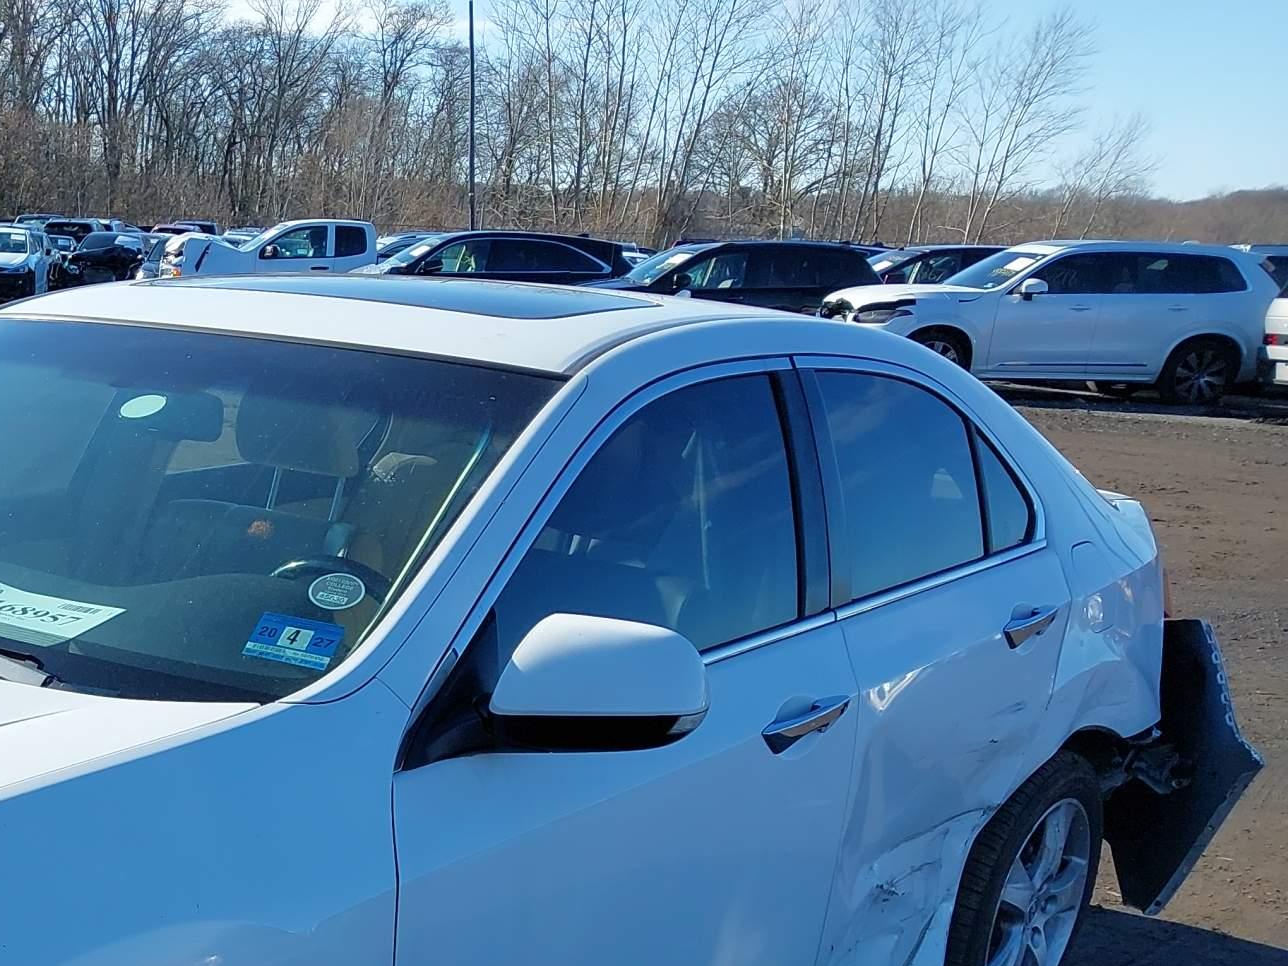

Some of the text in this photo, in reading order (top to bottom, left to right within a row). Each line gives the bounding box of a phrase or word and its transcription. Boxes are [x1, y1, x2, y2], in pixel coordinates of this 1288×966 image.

[258, 626, 337, 649] 20 4 27
